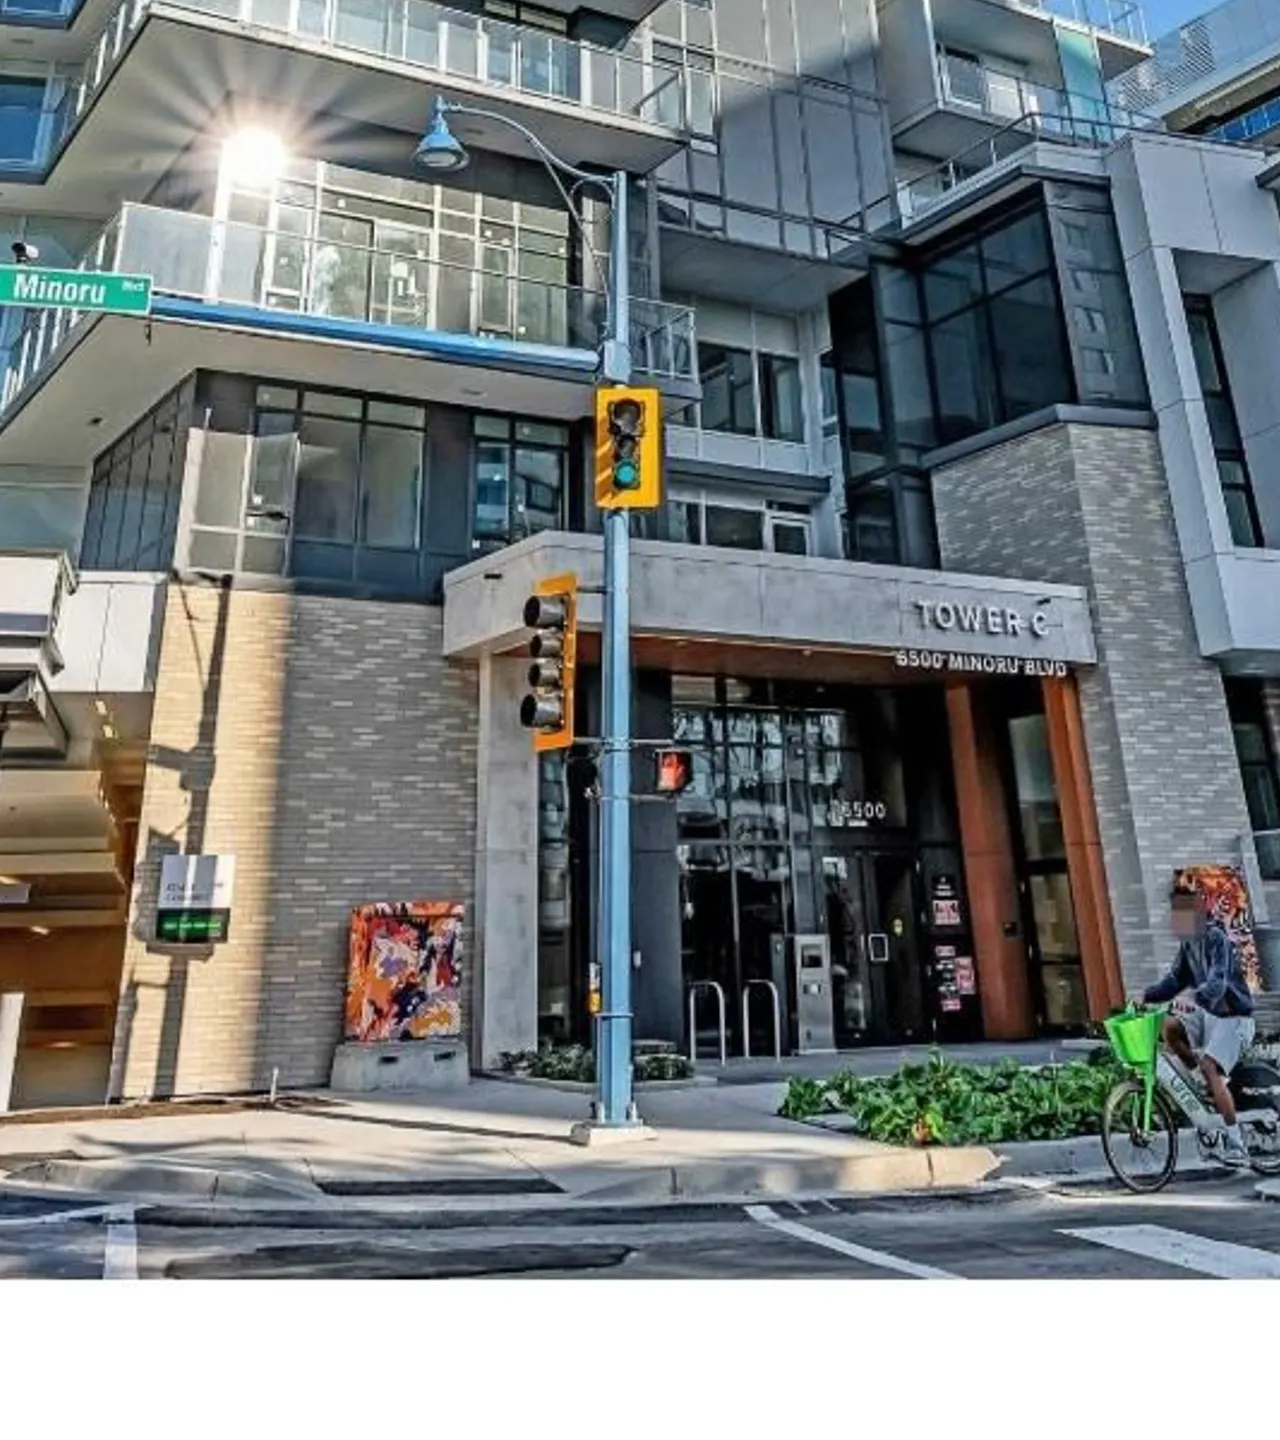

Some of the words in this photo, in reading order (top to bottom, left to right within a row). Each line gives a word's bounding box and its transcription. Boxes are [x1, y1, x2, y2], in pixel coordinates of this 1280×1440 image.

[12, 273, 106, 304] Minoru
[915, 599, 1021, 636] TOWER
[1031, 611, 1050, 636] C
[947, 652, 1019, 674] MINORU
[1023, 659, 1067, 677] BLVD
